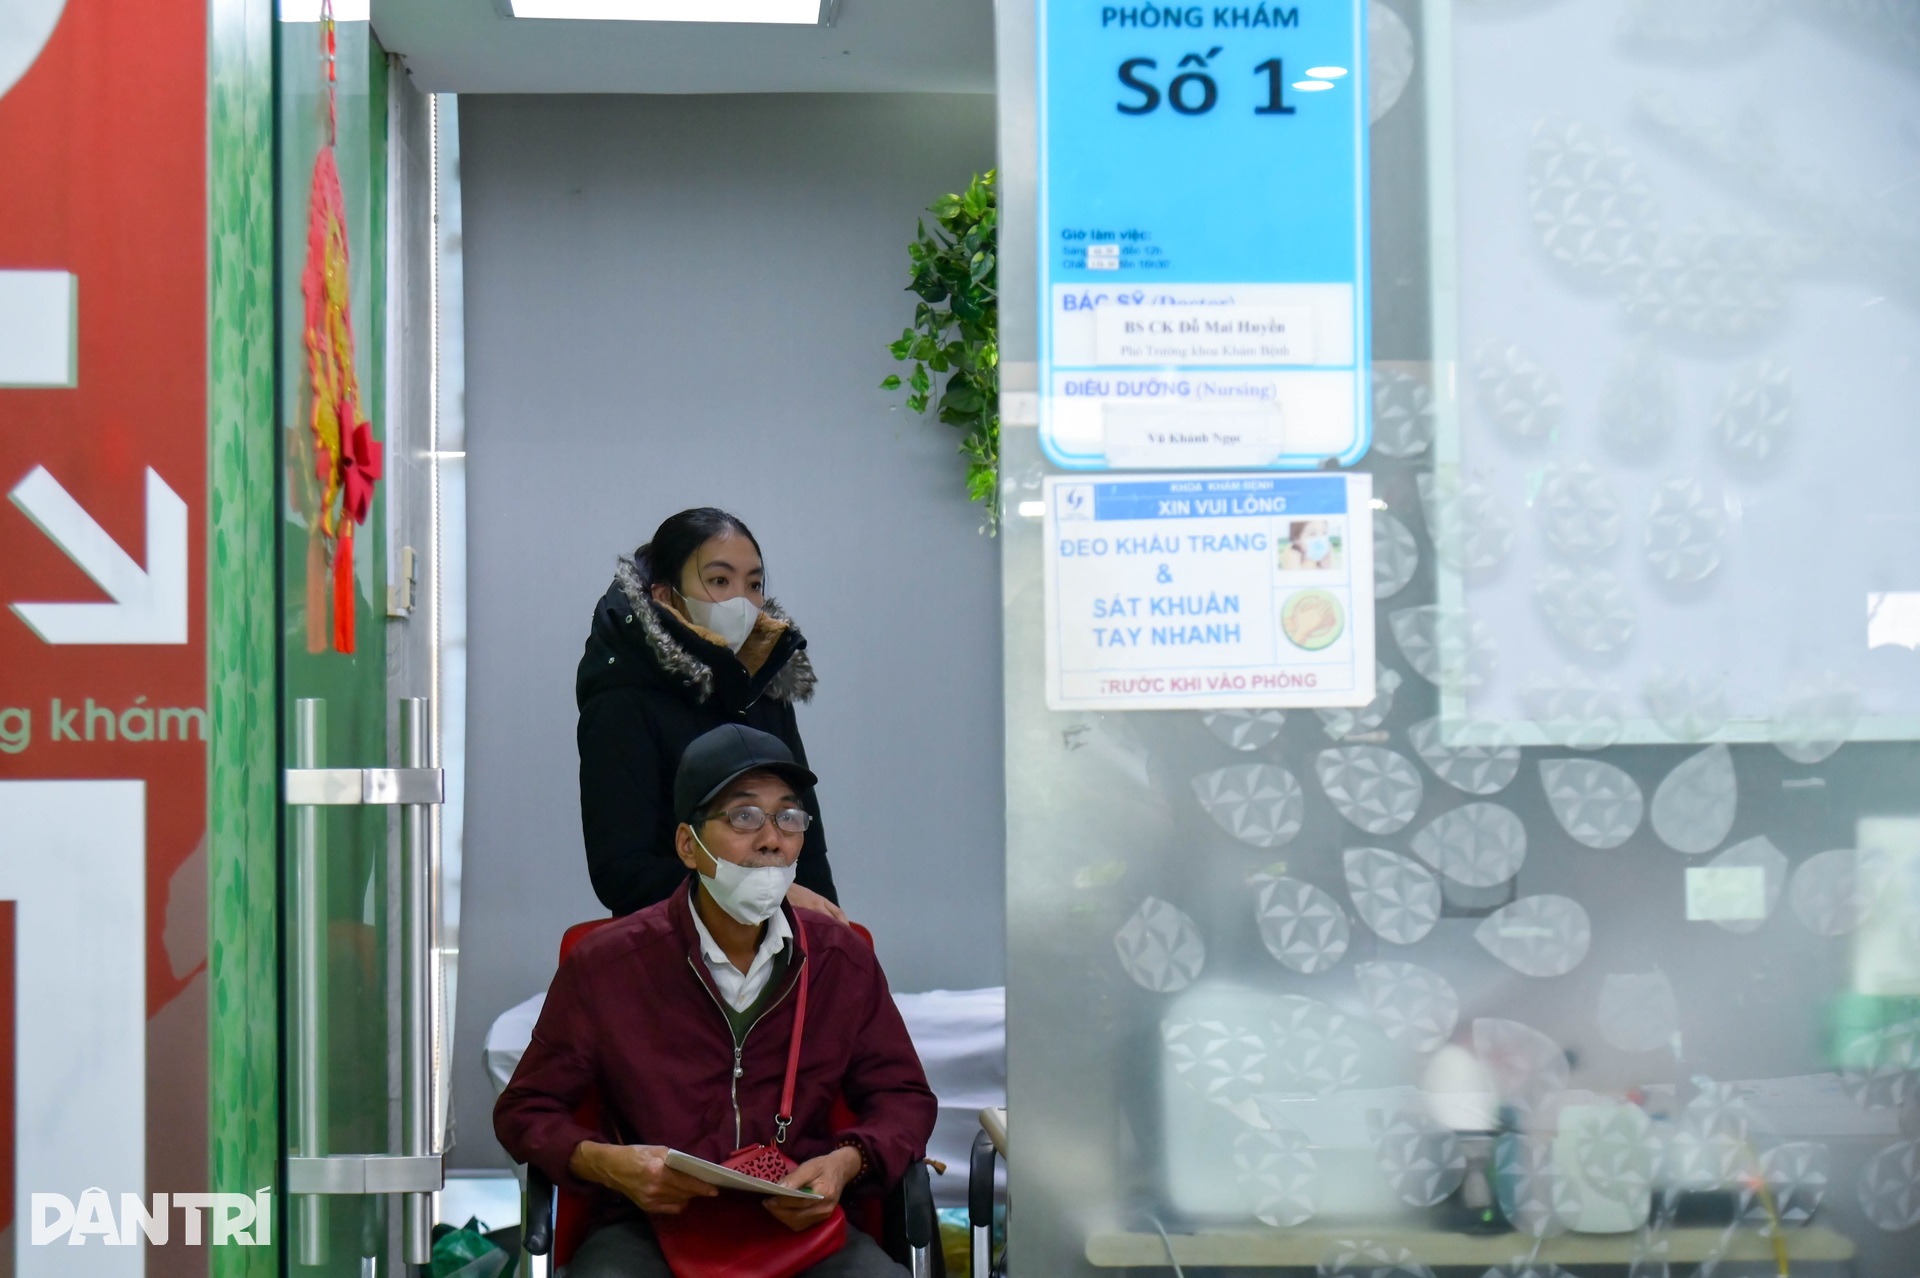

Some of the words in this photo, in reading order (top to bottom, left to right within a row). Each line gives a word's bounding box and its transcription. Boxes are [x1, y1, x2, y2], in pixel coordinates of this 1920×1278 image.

[1101, 3, 1203, 29] PHÒNG
[1213, 2, 1300, 29] KHÁM
[1116, 46, 1224, 116] Số
[1253, 57, 1297, 116] 1
[1061, 228, 1087, 241] Giờ
[1091, 228, 1115, 241] làm
[1124, 320, 1145, 334] BS
[1148, 320, 1174, 334] CK
[1204, 320, 1233, 334] Mai
[1196, 381, 1278, 400] (Nursing)
[1158, 498, 1191, 516] XIN
[1194, 497, 1228, 515] VUI
[1059, 538, 1108, 557] ĐEO
[1187, 532, 1268, 553] TRANG
[1156, 563, 1174, 583] &
[1092, 592, 1142, 619] SÁT
[1092, 627, 1142, 647] TAY
[1150, 623, 1241, 646] NHANH
[1170, 676, 1201, 693] KHI
[51, 695, 208, 742] khám
